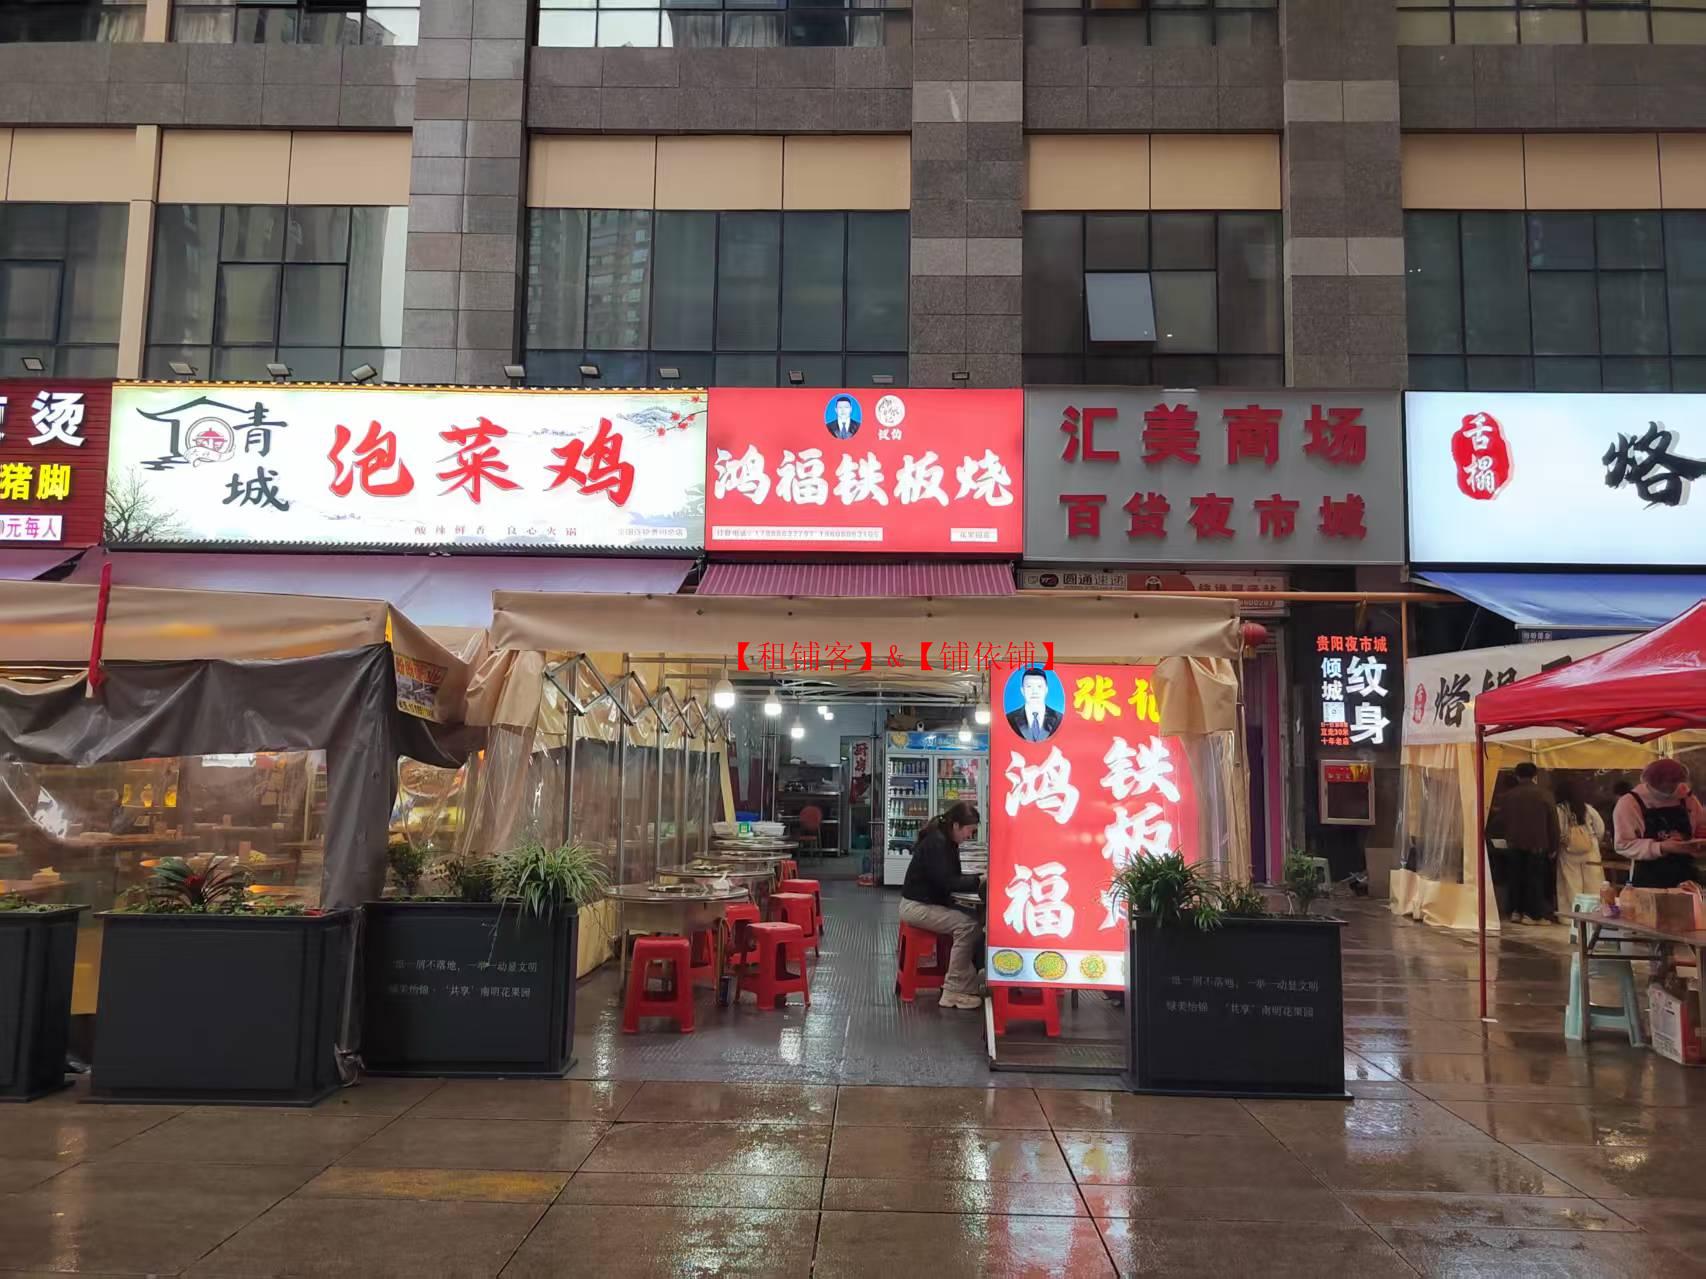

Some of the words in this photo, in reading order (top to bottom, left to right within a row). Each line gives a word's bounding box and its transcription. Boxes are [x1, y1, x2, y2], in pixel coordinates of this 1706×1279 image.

[0, 390, 85, 447] 烫
[1060, 403, 1367, 466] 汇美商场
[0, 463, 71, 500] 猪脚
[222, 401, 290, 511] 青城
[327, 416, 636, 508] 泡菜鸡
[714, 444, 1014, 507] 鸿福铁板烧
[414, 524, 487, 536] 酸辣鲜香
[507, 525, 577, 537] 良心火锅
[1059, 492, 1367, 541] 百货夜市城
[1316, 635, 1388, 653] 贵阳夜市城
[1321, 657, 1344, 701] 倾城
[1346, 655, 1391, 745] 纹身
[1003, 745, 1080, 938] 鸿福
